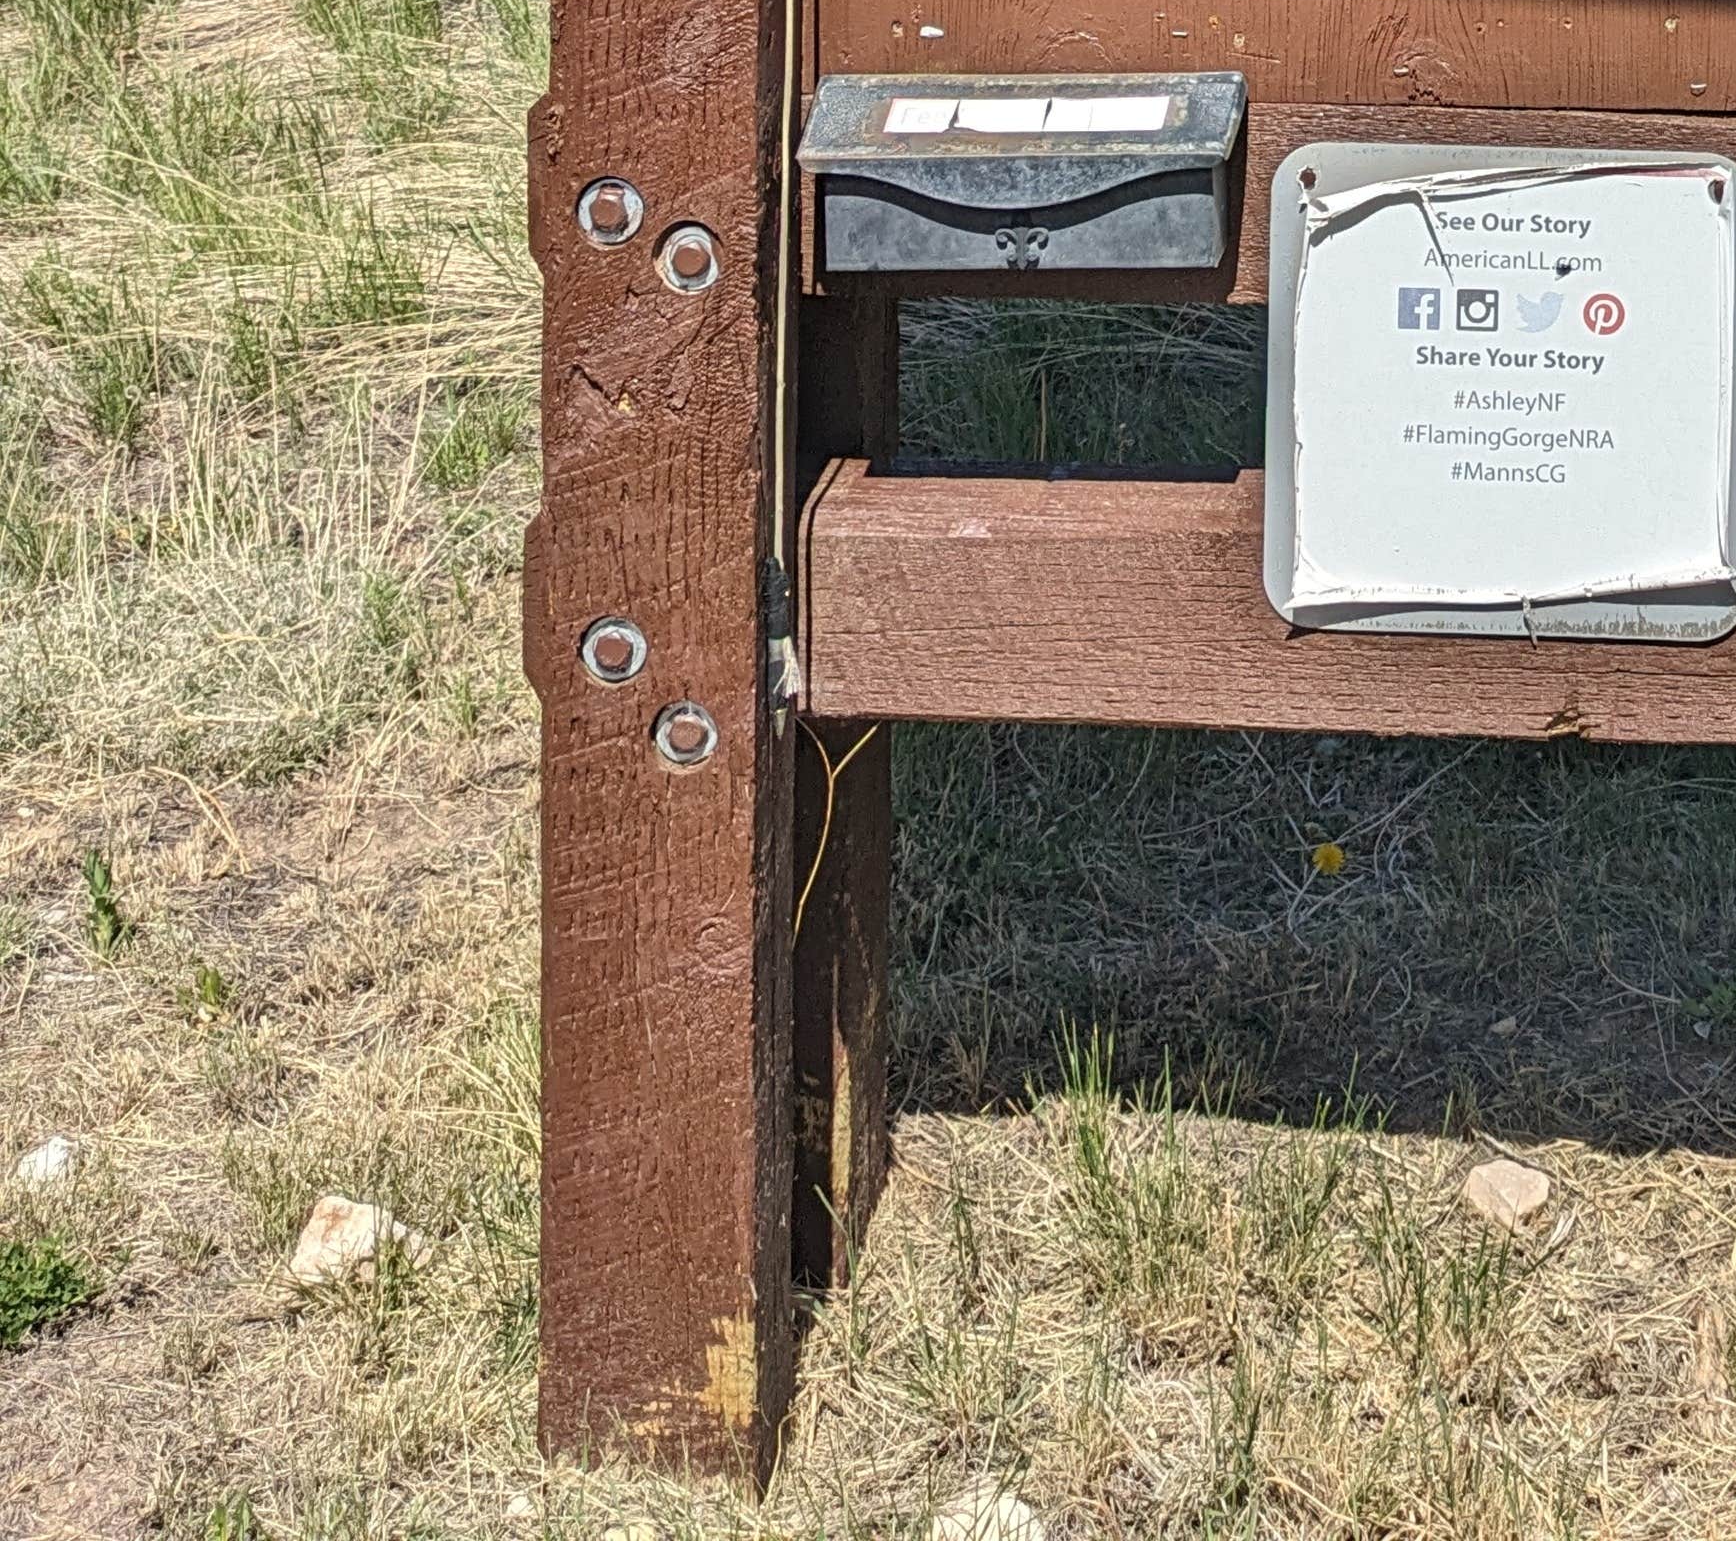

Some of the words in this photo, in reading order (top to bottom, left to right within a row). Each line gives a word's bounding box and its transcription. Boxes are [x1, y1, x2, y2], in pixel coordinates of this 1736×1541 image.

[1435, 212, 1475, 230] See
[1482, 213, 1524, 232] Our
[1530, 214, 1591, 239] Story
[1424, 248, 1602, 272] AmericanLL.com
[1416, 346, 1481, 366] Share
[1486, 348, 1538, 368] Your
[1543, 350, 1604, 375] Story
[1453, 390, 1566, 416] #AshleyNF
[1403, 424, 1614, 452] #FlamingGorgeNRA
[1451, 462, 1566, 483] #MannsCG
